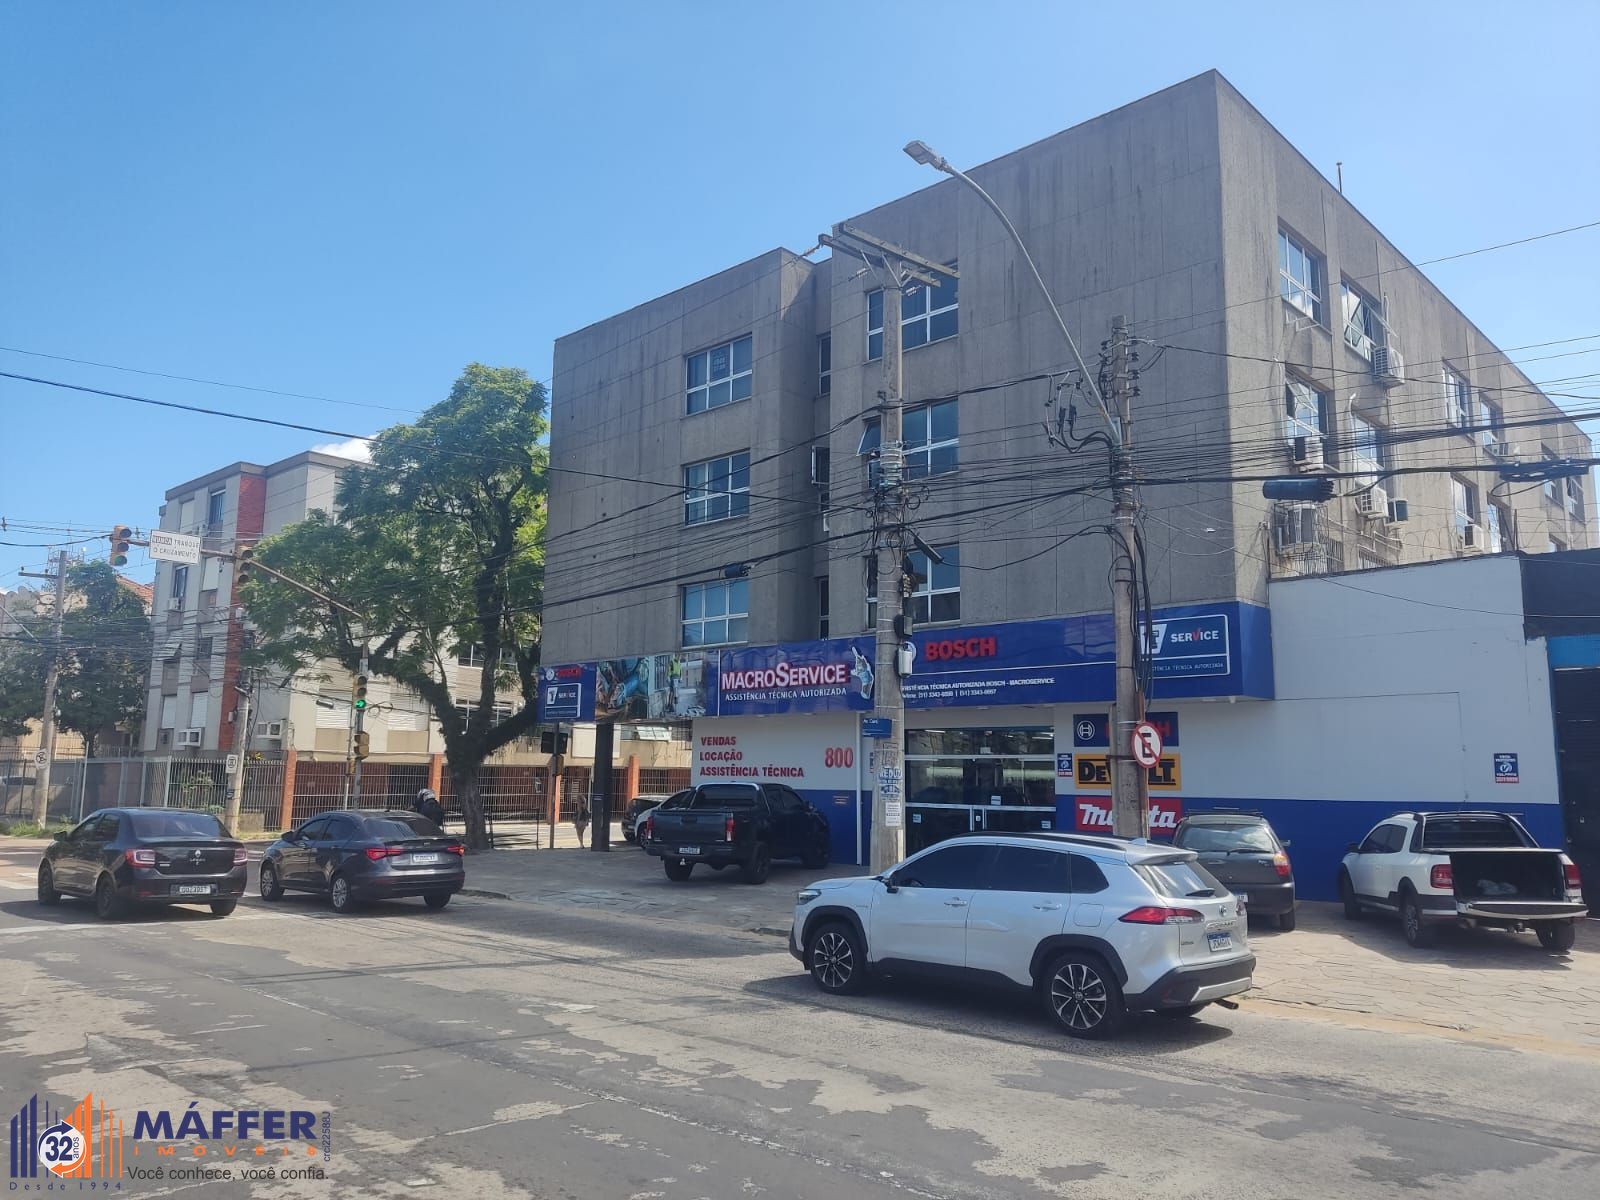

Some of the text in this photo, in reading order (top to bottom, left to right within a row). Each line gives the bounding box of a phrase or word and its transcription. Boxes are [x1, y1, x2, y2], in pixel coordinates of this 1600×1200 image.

[174, 539, 199, 549] TRANQUE
[160, 548, 197, 558] CRUZAMENTO
[1171, 628, 1219, 643] SERVICE
[925, 638, 996, 661] BOSCH
[725, 687, 847, 701] ASSISTÊNCIA TÉCNICA AUTORIZADA
[701, 736, 736, 746] VENDAS
[700, 749, 742, 762] LOCAÇÃO
[824, 747, 854, 768] 800
[700, 763, 804, 777] ASSISTÊNCIA TÉCNICA
